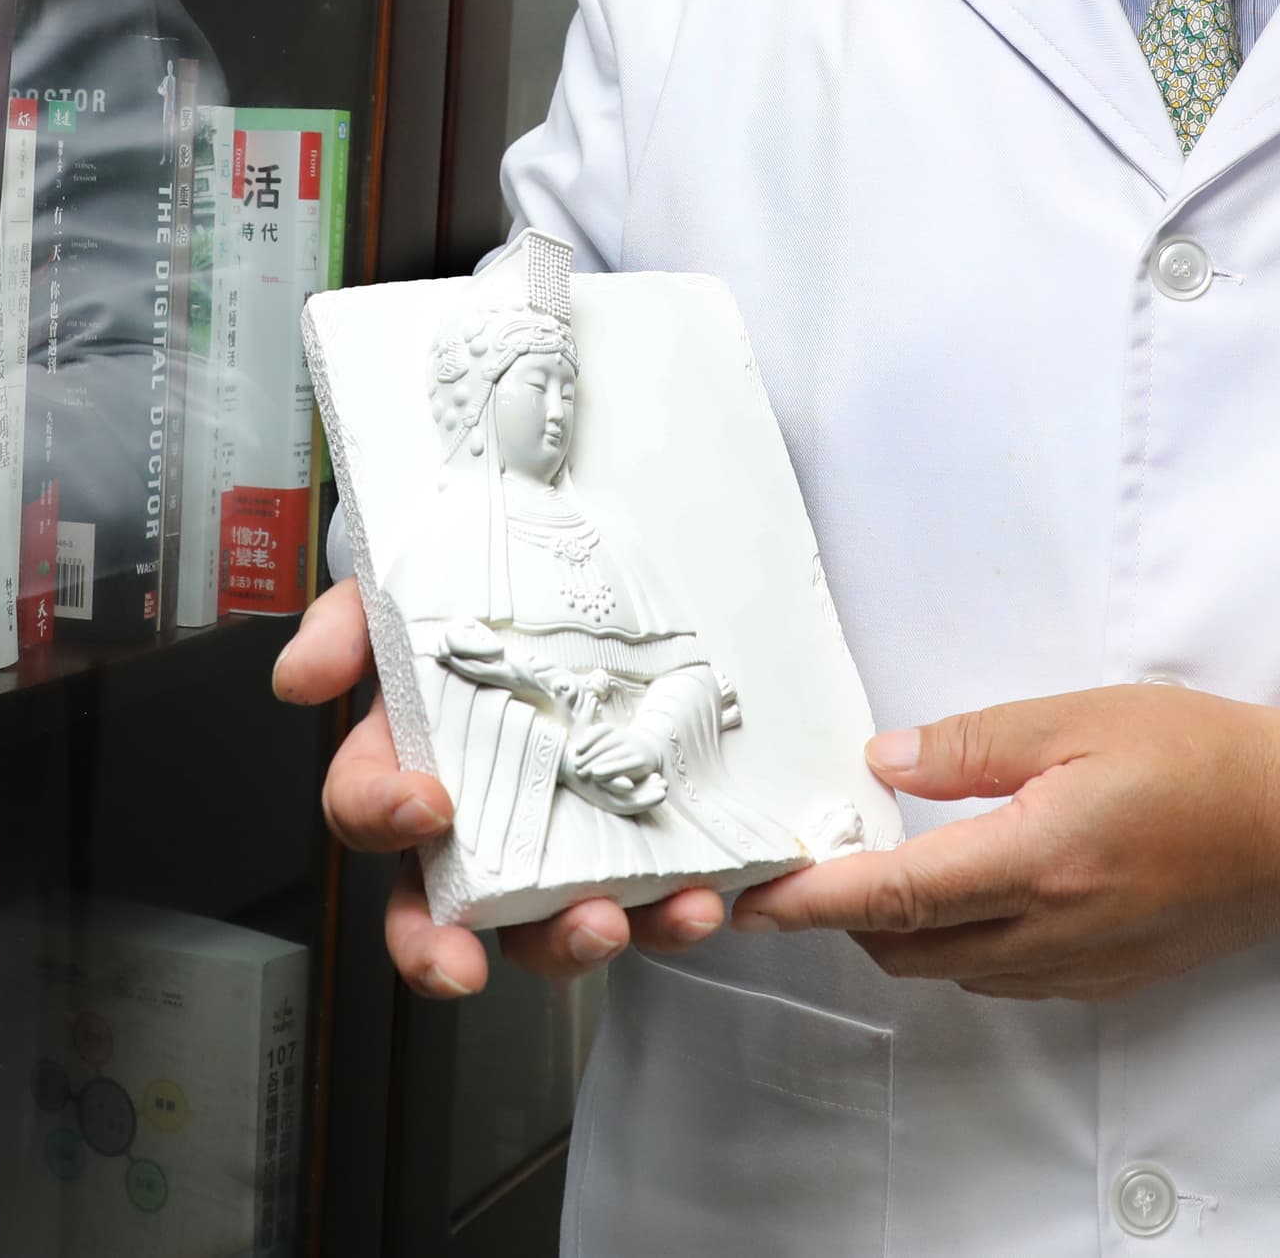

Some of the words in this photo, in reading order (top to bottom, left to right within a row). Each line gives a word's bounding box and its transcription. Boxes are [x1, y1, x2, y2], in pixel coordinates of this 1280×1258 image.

[156, 182, 173, 245] THE
[241, 221, 280, 244] 時代
[48, 206, 64, 374] 有一天，你也會遇到
[151, 260, 170, 391] DIGITAL
[145, 406, 165, 539] DOCTOR
[36, 599, 49, 638] 天下
[266, 1040, 299, 1069] 107
